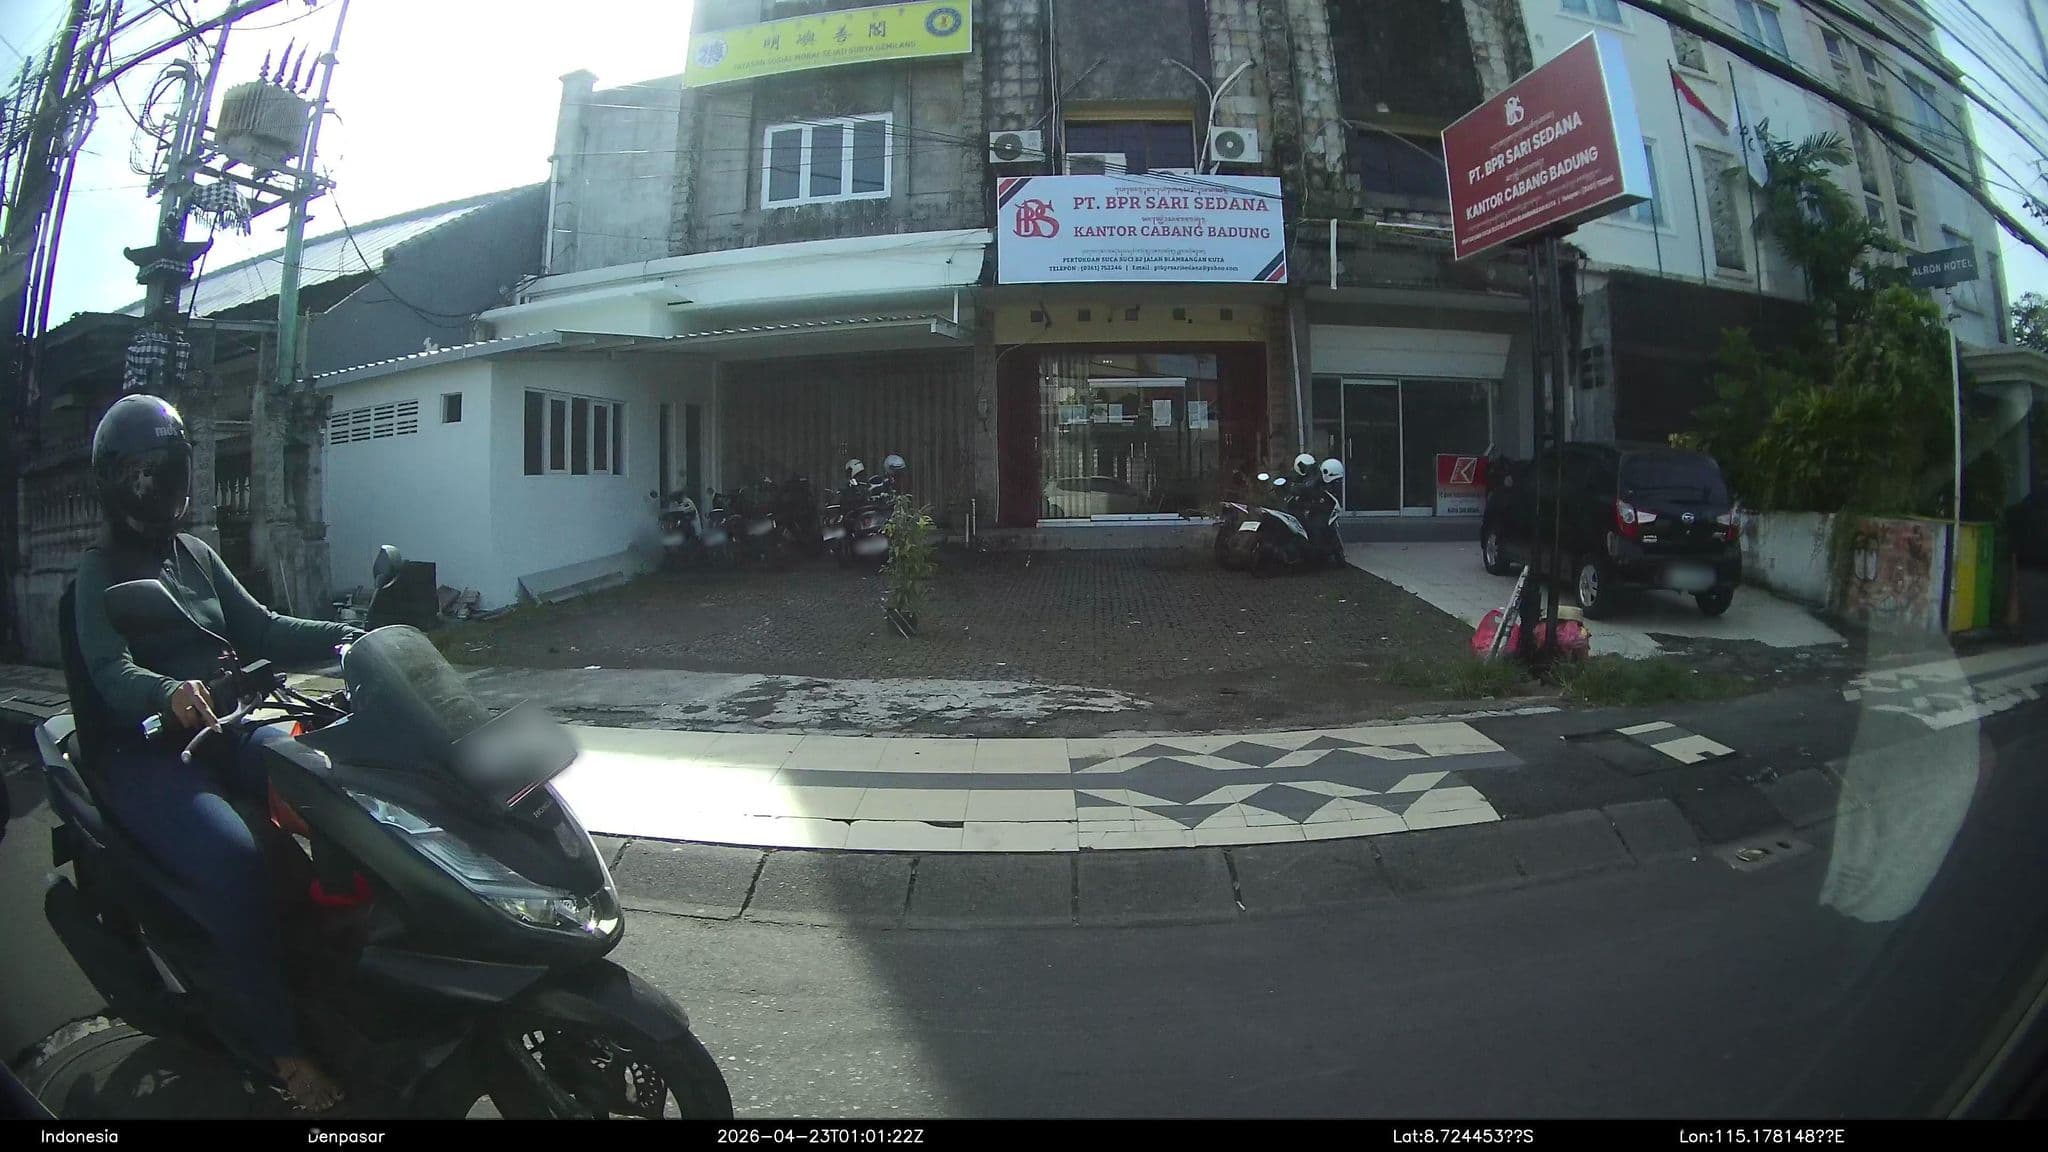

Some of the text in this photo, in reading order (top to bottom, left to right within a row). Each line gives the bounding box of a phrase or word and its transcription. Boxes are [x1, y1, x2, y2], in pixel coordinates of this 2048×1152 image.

[1468, 165, 1485, 185] PT.
[1485, 153, 1506, 176] BPR
[1506, 141, 1532, 165] SARI
[1532, 111, 1583, 150] SEDANA
[1466, 192, 1504, 221] KANTOR
[1504, 170, 1549, 202] CABANG
[1549, 146, 1599, 182] BADUNG
[1073, 196, 1270, 212] PT. BPR SARI SEDANA
[1073, 225, 1271, 240] KANTOR CABANG BADUNG
[1912, 258, 1973, 276] ALRON HOTEL
